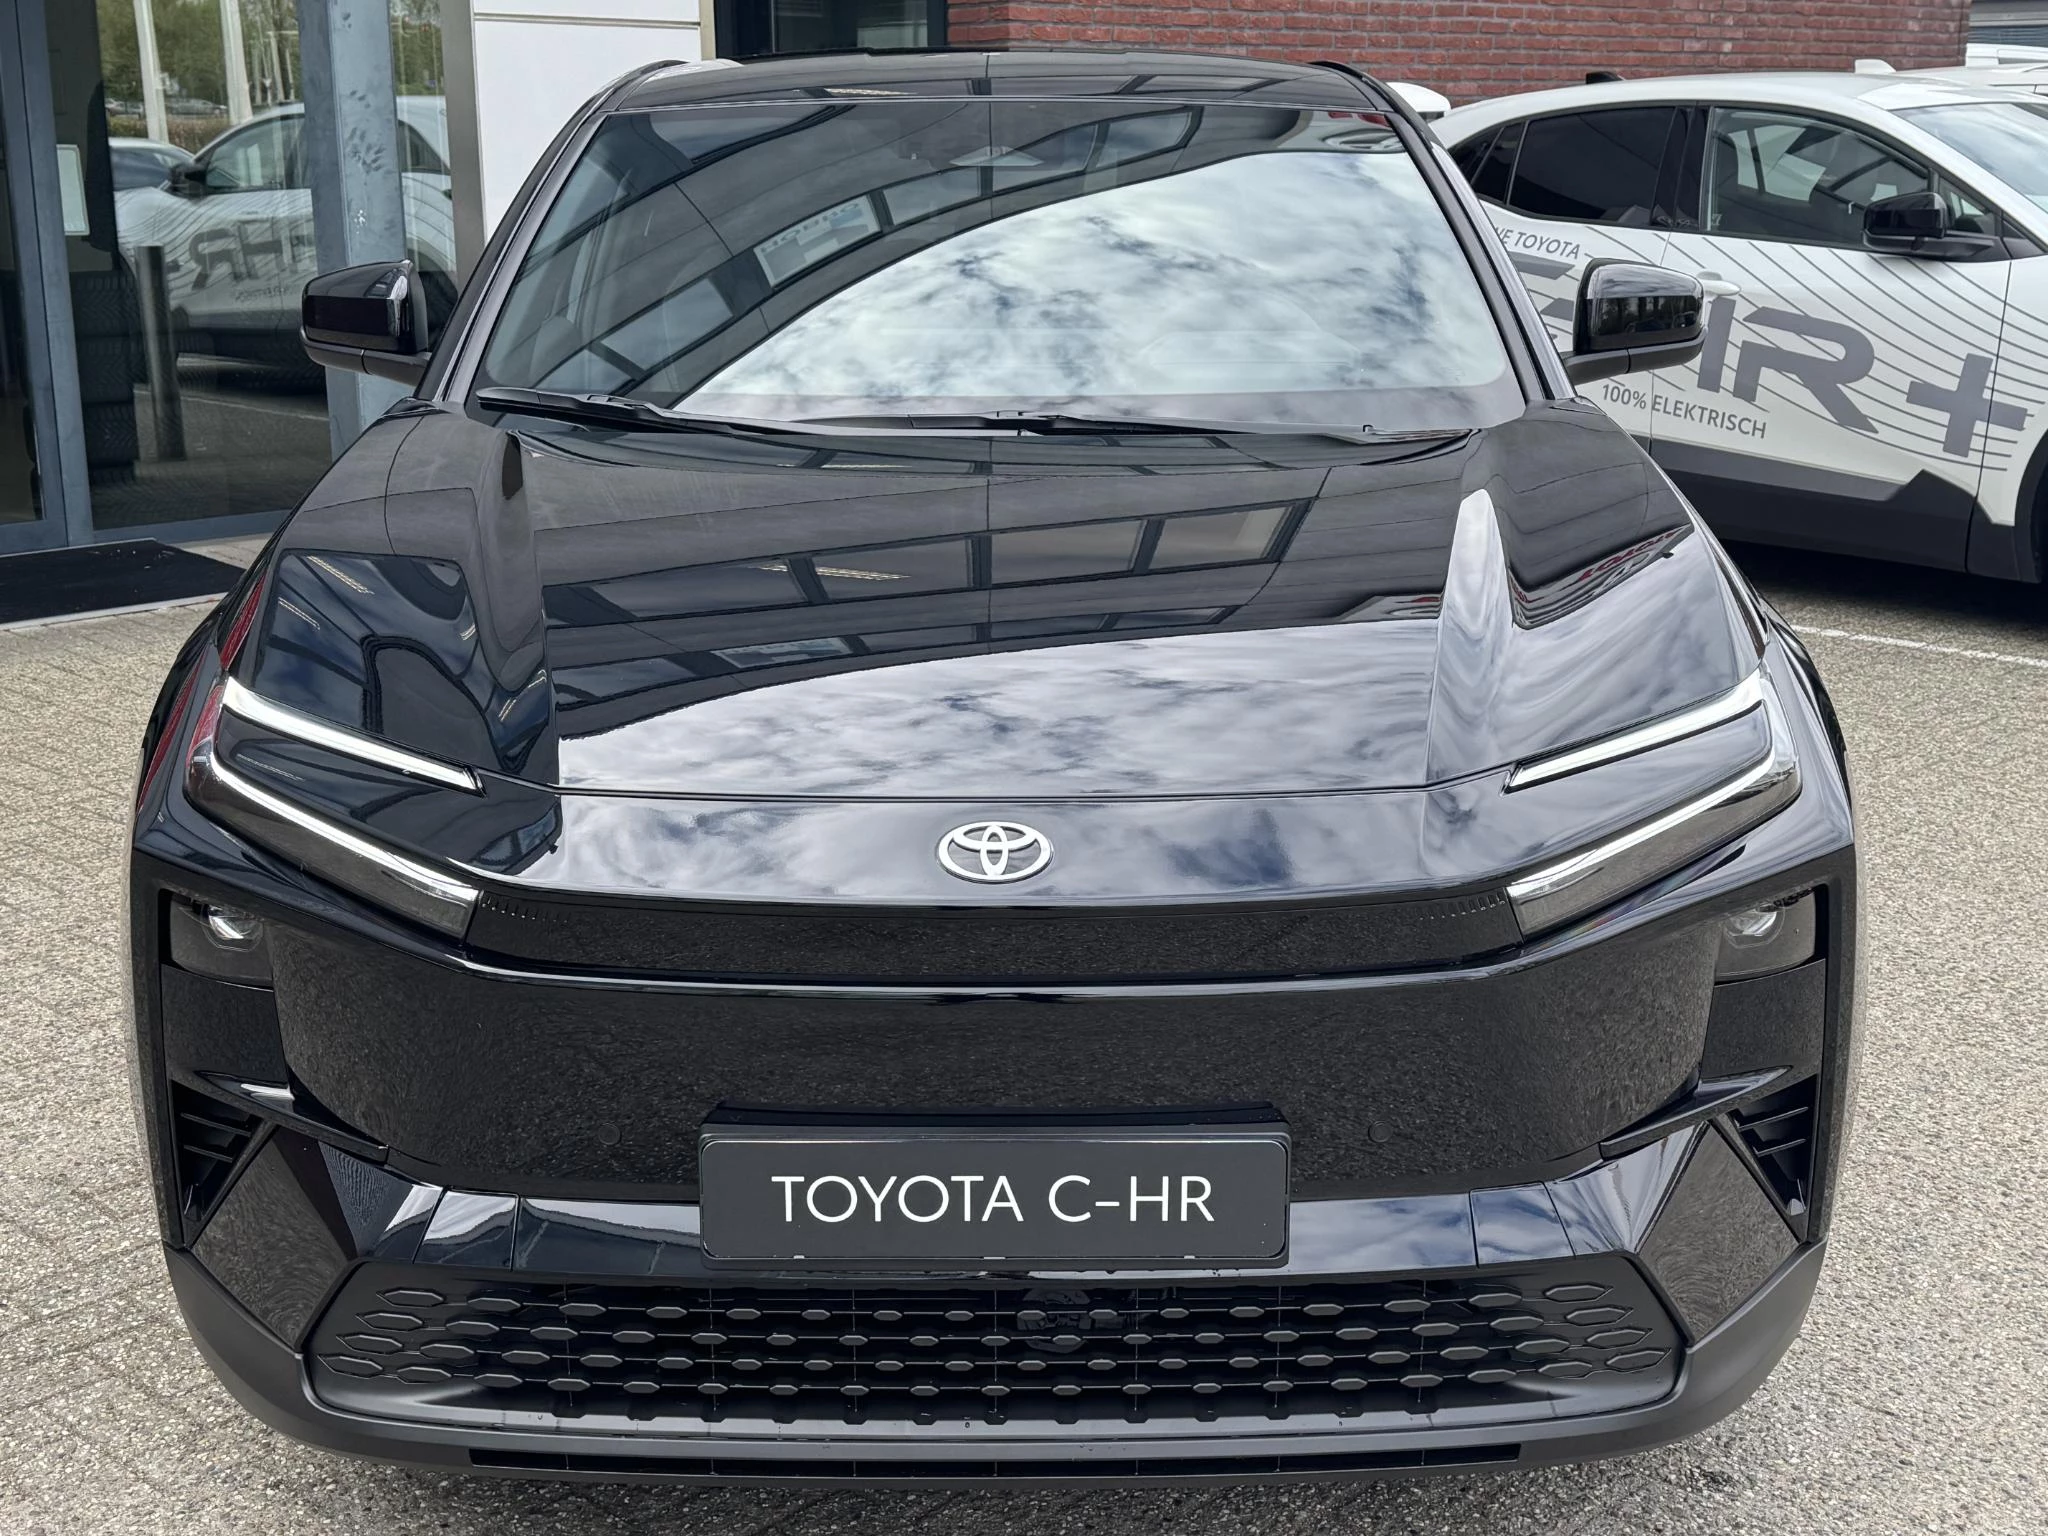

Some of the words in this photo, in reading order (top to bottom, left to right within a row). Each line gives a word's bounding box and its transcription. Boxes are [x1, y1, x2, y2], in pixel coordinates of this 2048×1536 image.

[1514, 231, 1581, 260] TOYOTA
[1602, 383, 1647, 410] 100%
[1652, 394, 1768, 439] ELEKTRISCH
[771, 1174, 1025, 1223] TOYOTA
[1048, 1174, 1215, 1223] C-HR
